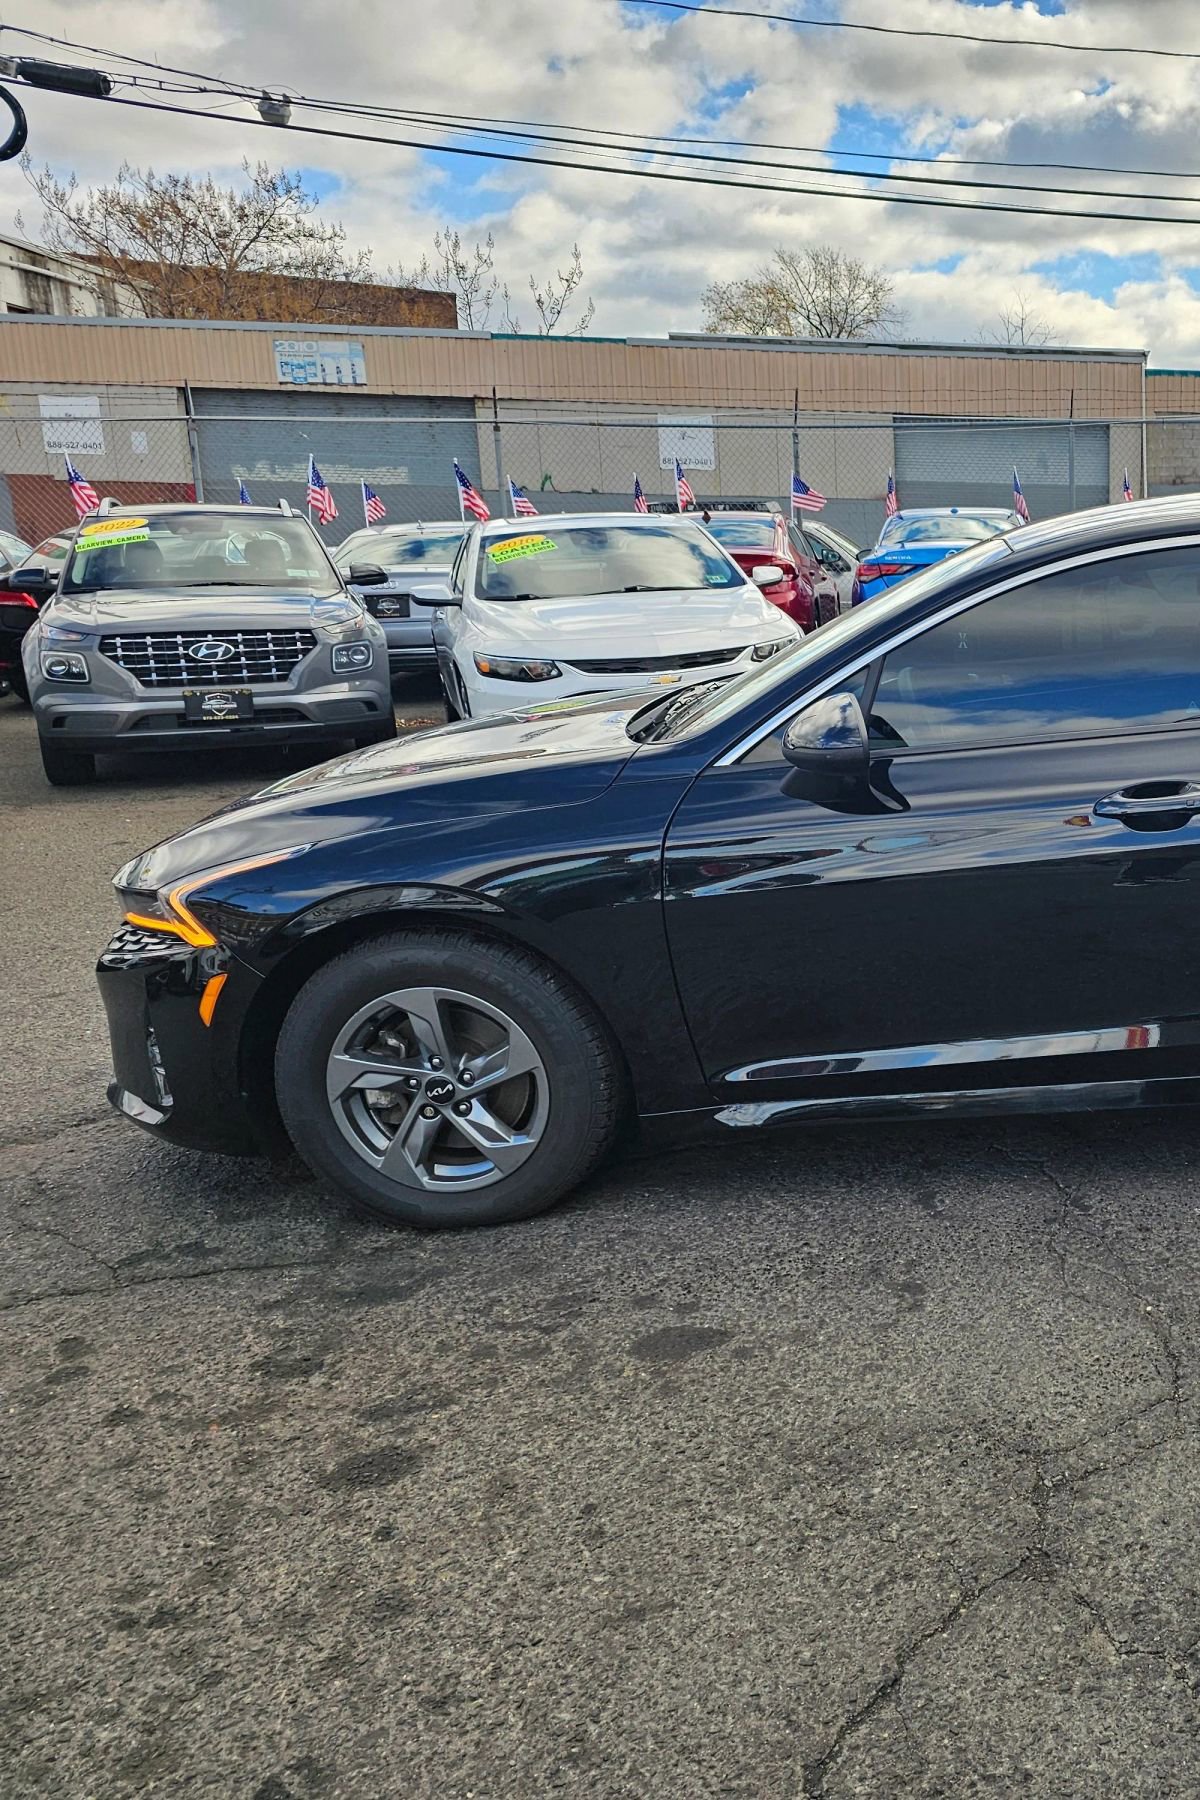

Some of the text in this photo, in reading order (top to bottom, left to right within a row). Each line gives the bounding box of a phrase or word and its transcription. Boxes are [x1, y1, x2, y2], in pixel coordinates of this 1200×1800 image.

[662, 457, 713, 466] 88527-0401
[93, 520, 137, 533] 2022
[76, 534, 147, 550] REARVIEW CAMERA
[491, 540, 550, 558] LOADED
